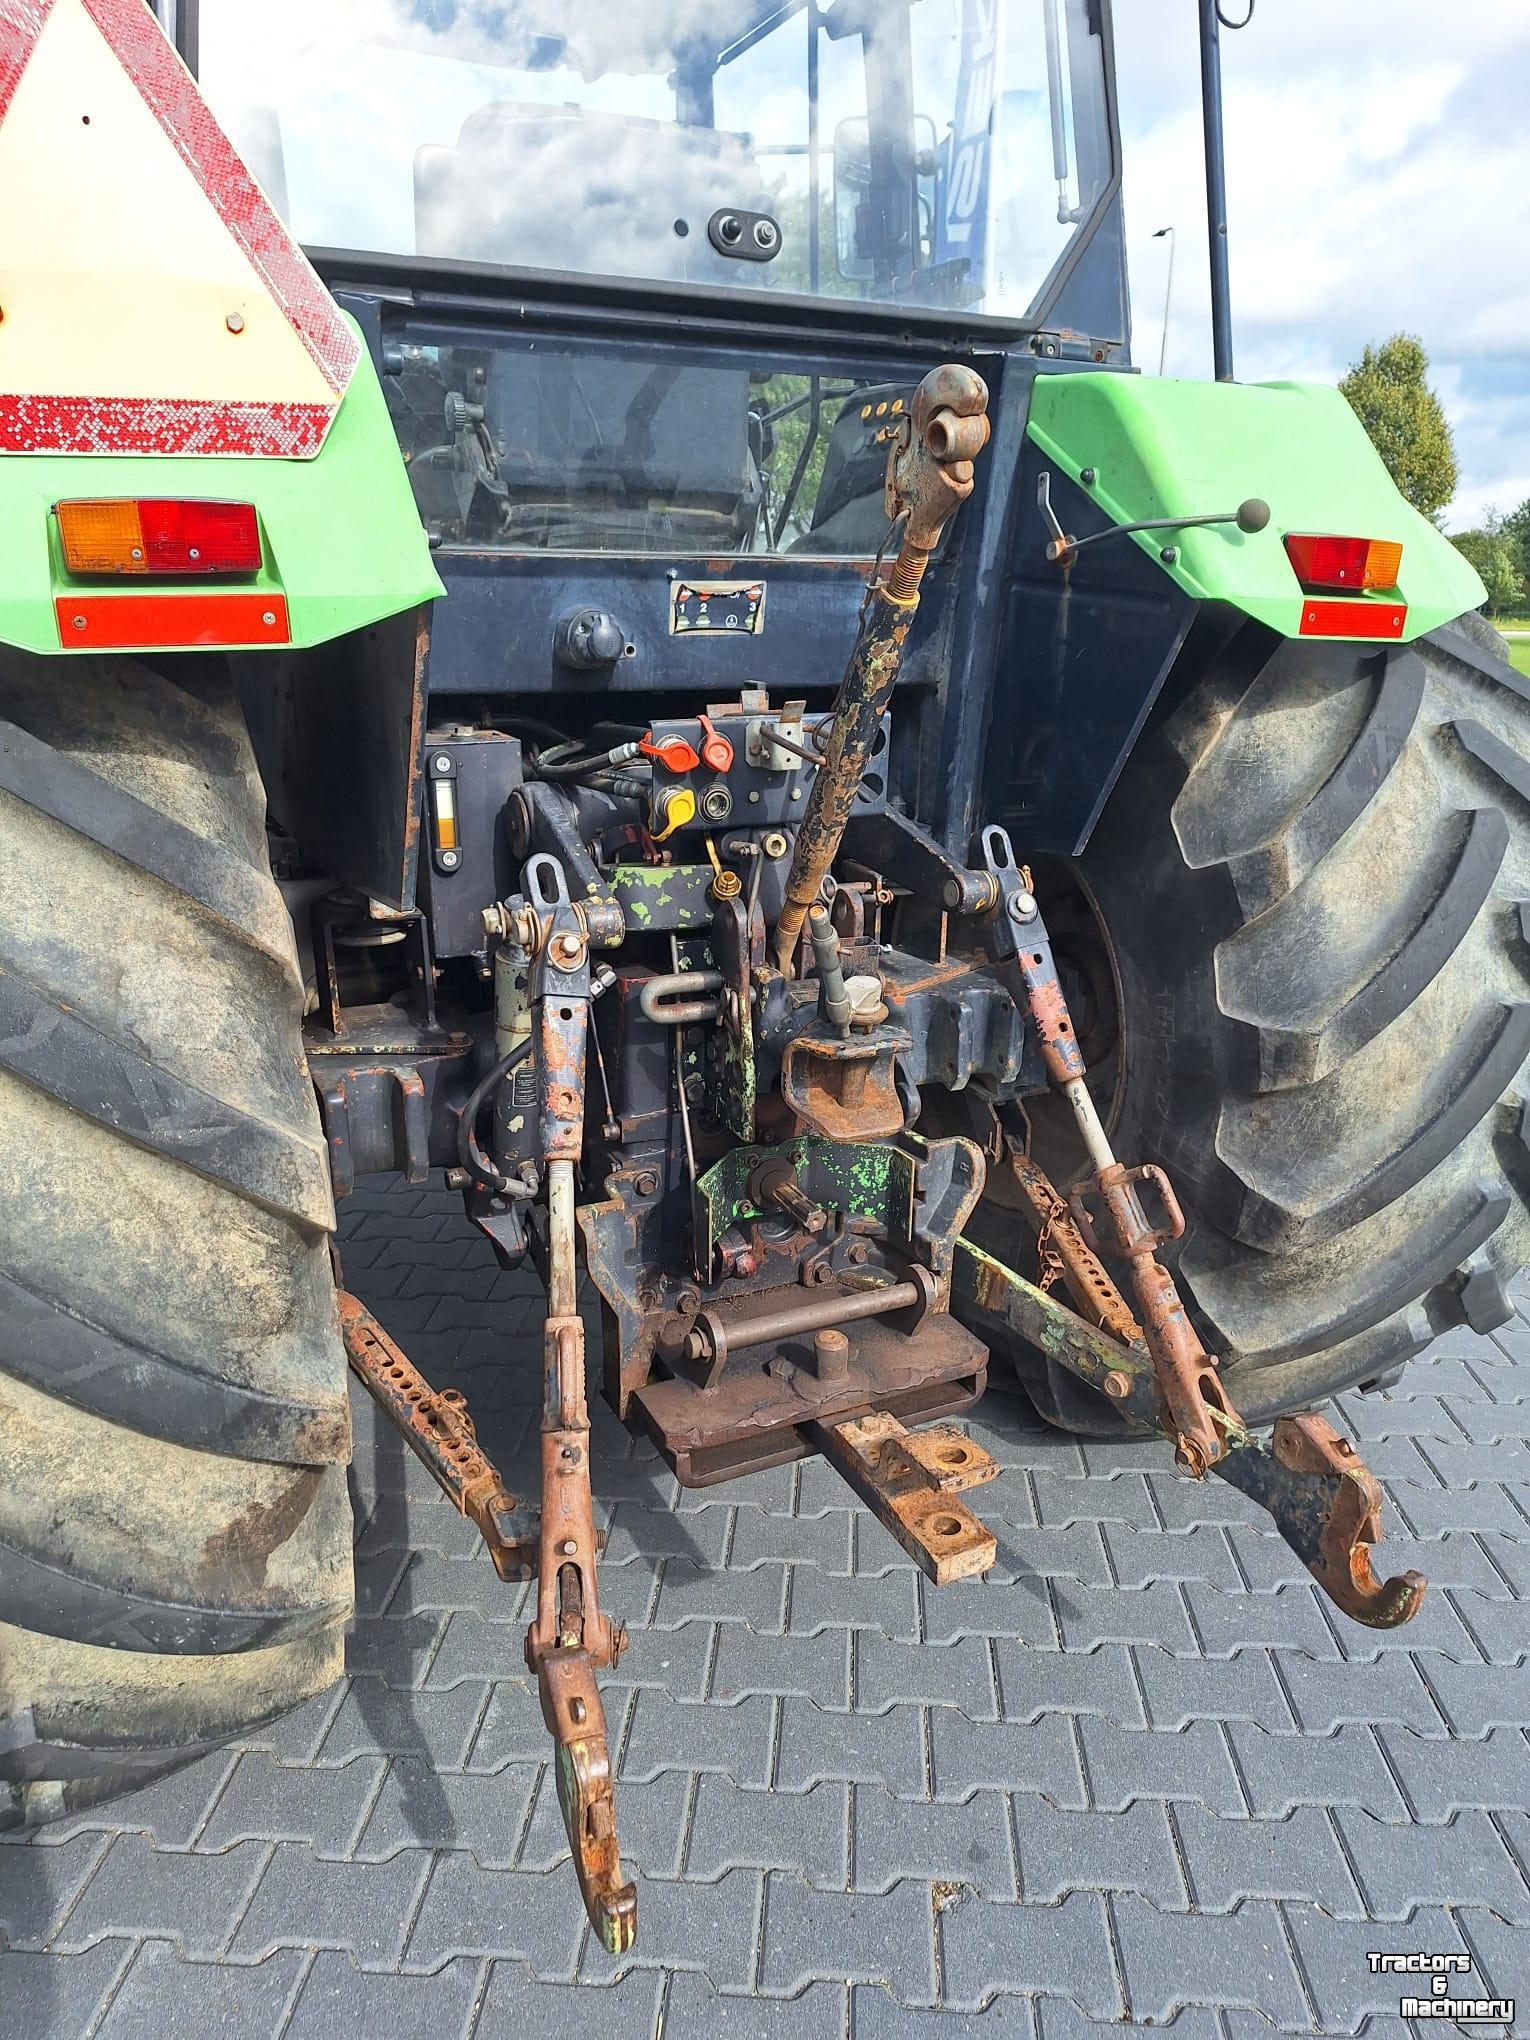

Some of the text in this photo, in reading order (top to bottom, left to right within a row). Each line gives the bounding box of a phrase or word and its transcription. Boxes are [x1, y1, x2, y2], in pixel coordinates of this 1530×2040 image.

[679, 602, 757, 613] 1 2 3
